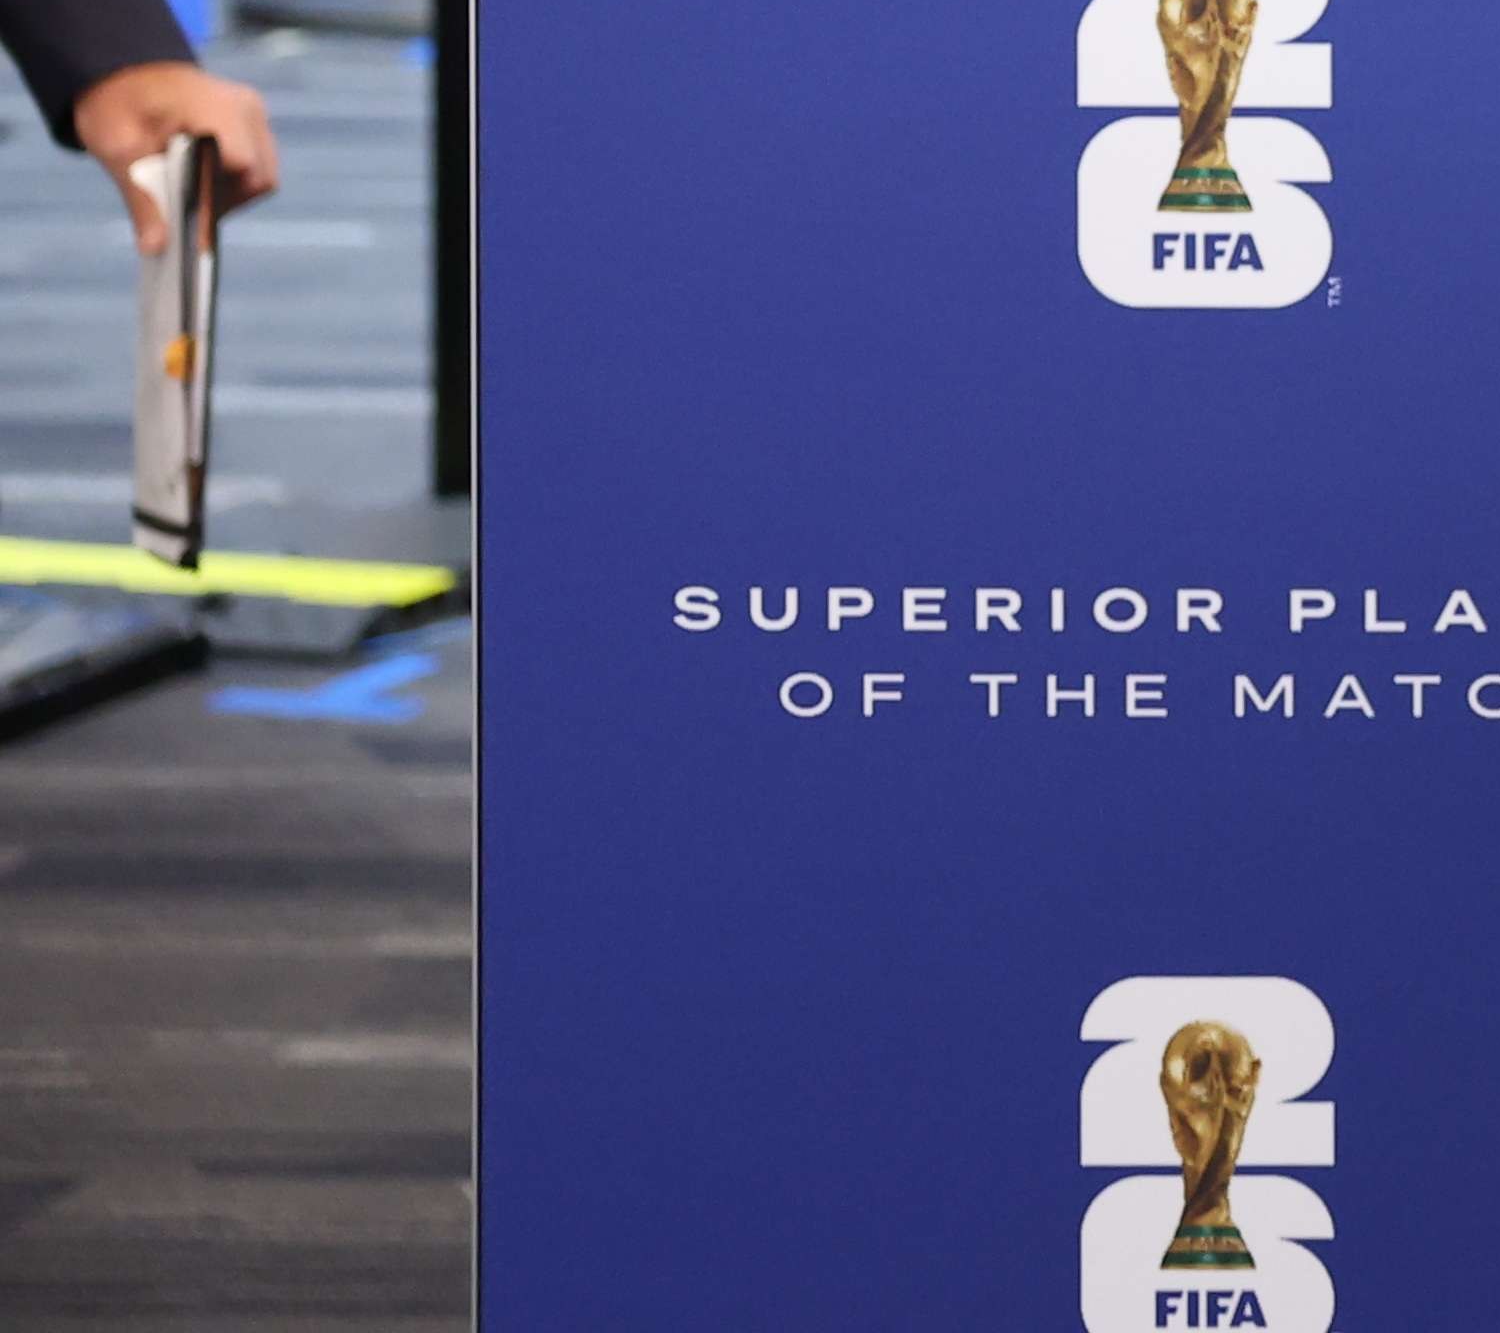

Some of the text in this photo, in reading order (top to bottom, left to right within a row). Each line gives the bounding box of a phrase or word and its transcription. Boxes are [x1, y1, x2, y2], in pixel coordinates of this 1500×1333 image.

[1151, 231, 1263, 272] FIFA
[672, 585, 1224, 634] SUPERIOR
[778, 671, 906, 719] OF
[968, 672, 1170, 719] THE
[1155, 1289, 1266, 1328] FIFA
